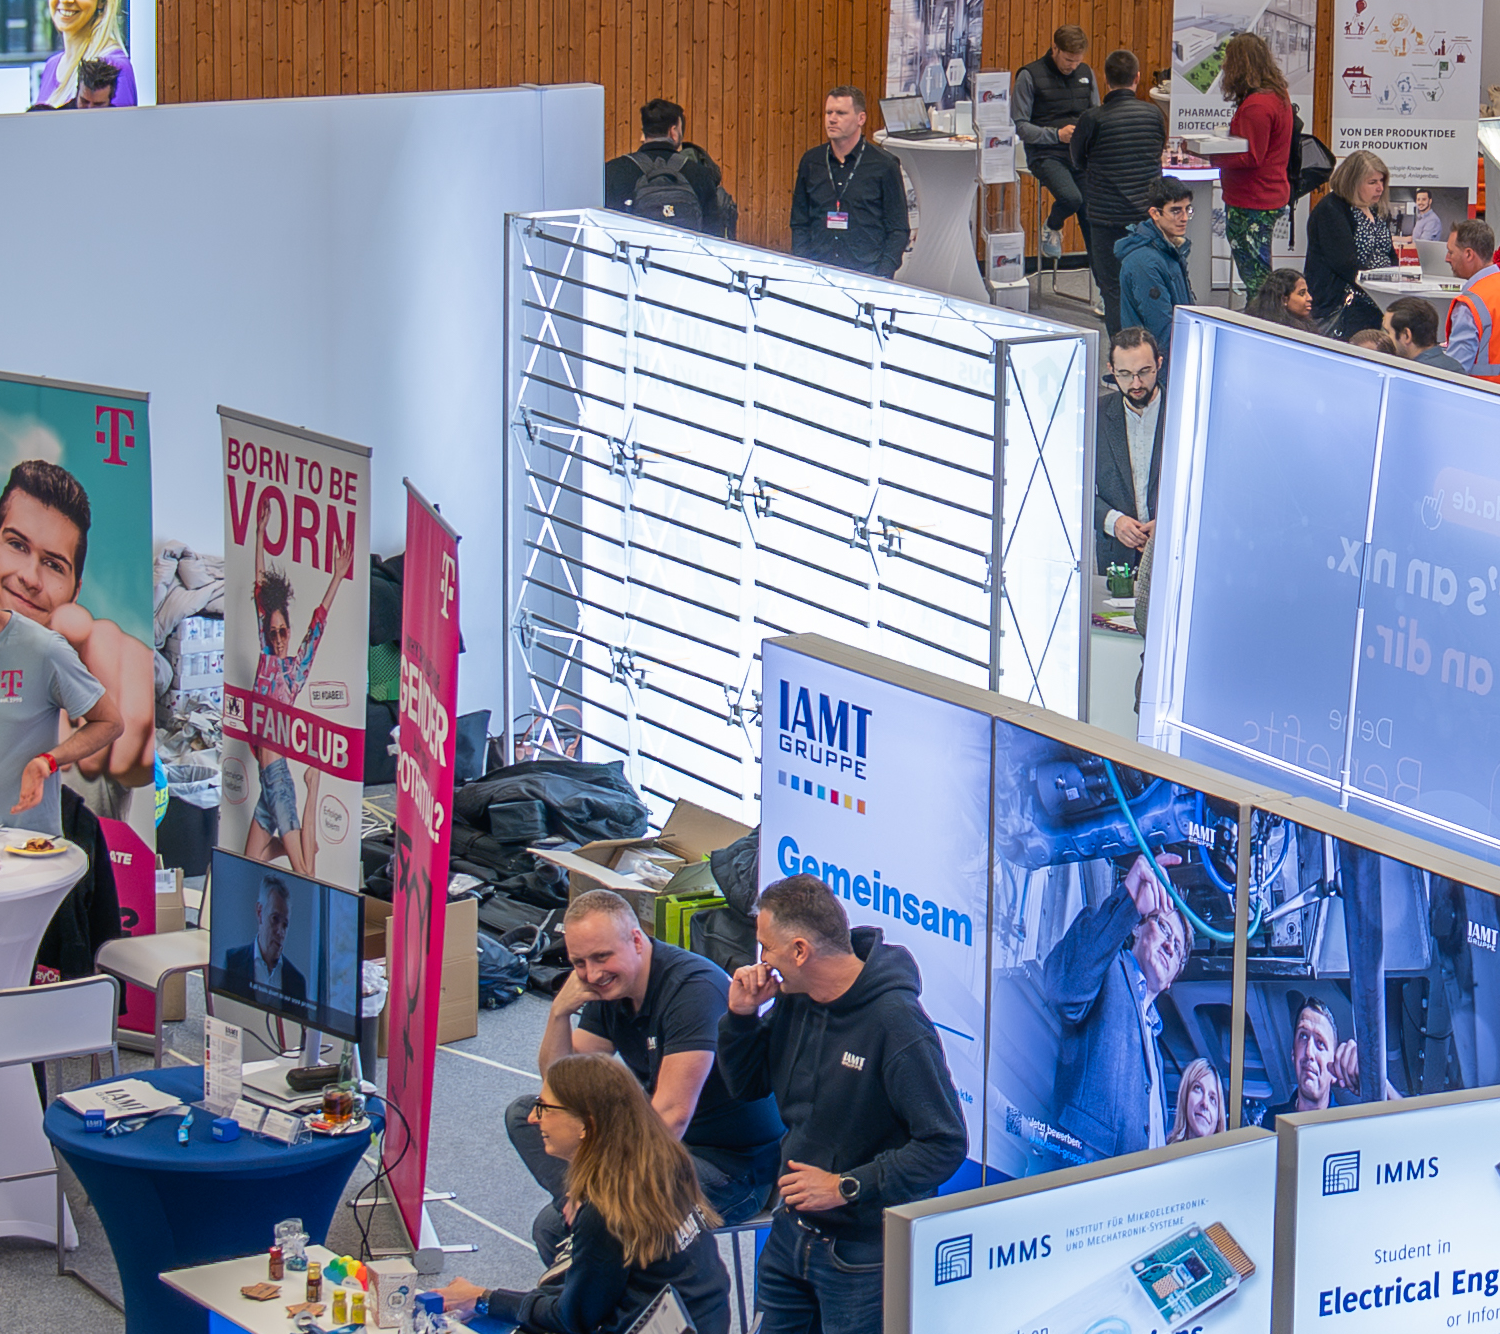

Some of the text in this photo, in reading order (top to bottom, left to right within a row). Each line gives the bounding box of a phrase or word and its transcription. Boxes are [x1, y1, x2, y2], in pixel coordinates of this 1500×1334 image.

[1340, 128, 1456, 138] VON DER PRODUKTIDEE
[1340, 141, 1428, 150] ZUR PRODUKTION
[227, 437, 358, 507] BORN TO BE
[226, 474, 357, 581] VORN
[251, 701, 350, 770] FANCLUB
[780, 679, 873, 759] IAMT
[780, 734, 867, 780] GRUPPE
[1188, 821, 1216, 844] IAMT
[1468, 921, 1498, 944] IAMT
[842, 1052, 866, 1068] IAMT
[1376, 1156, 1439, 1186] IMMS
[988, 1234, 1052, 1270] IMMS
[1318, 1271, 1440, 1317] Electrical
